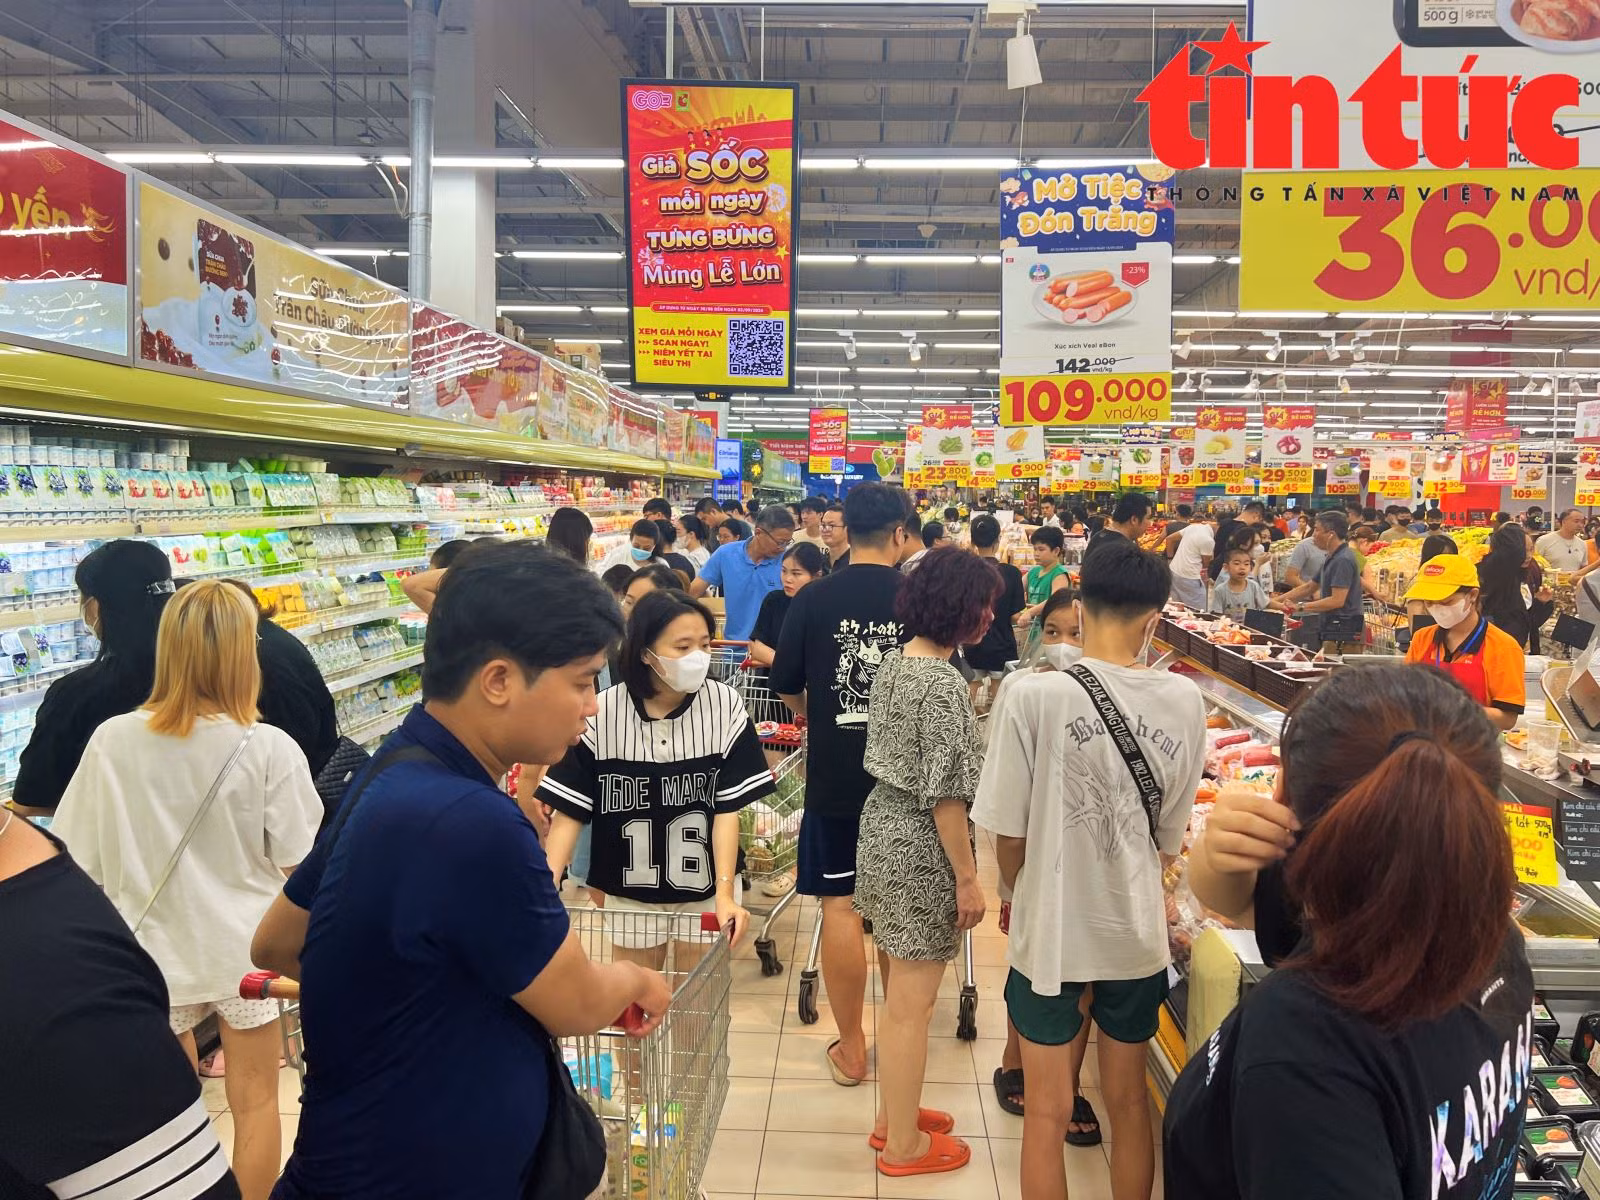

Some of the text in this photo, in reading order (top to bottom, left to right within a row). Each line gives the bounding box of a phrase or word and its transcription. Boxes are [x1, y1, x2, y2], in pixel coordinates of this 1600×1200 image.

[1424, 11, 1459, 24] 500 g
[641, 138, 768, 182] Giá SỐC
[1033, 171, 1143, 205] Mở Tiệc
[660, 188, 763, 217] mỗi ngày
[1018, 206, 1157, 237] Đón Trăng
[711, 225, 775, 249] BỪNG
[1313, 183, 1600, 301] 36.0
[642, 258, 781, 289] Mừng Lễ Lớn
[1126, 266, 1146, 274] -23%
[305, 304, 335, 329] Châu
[638, 326, 723, 337] XEM GIÁ MỖI NGÀY
[653, 339, 678, 347] SCAN
[653, 348, 713, 359] NIÊM YẾT TẠI
[653, 358, 691, 368] SIÊU THỊ
[1005, 377, 1167, 423] 109.000
[1104, 404, 1158, 420] vnd/kg
[1011, 464, 1043, 477] 6.900
[1503, 452, 1515, 467] 10
[622, 810, 713, 893] 16
